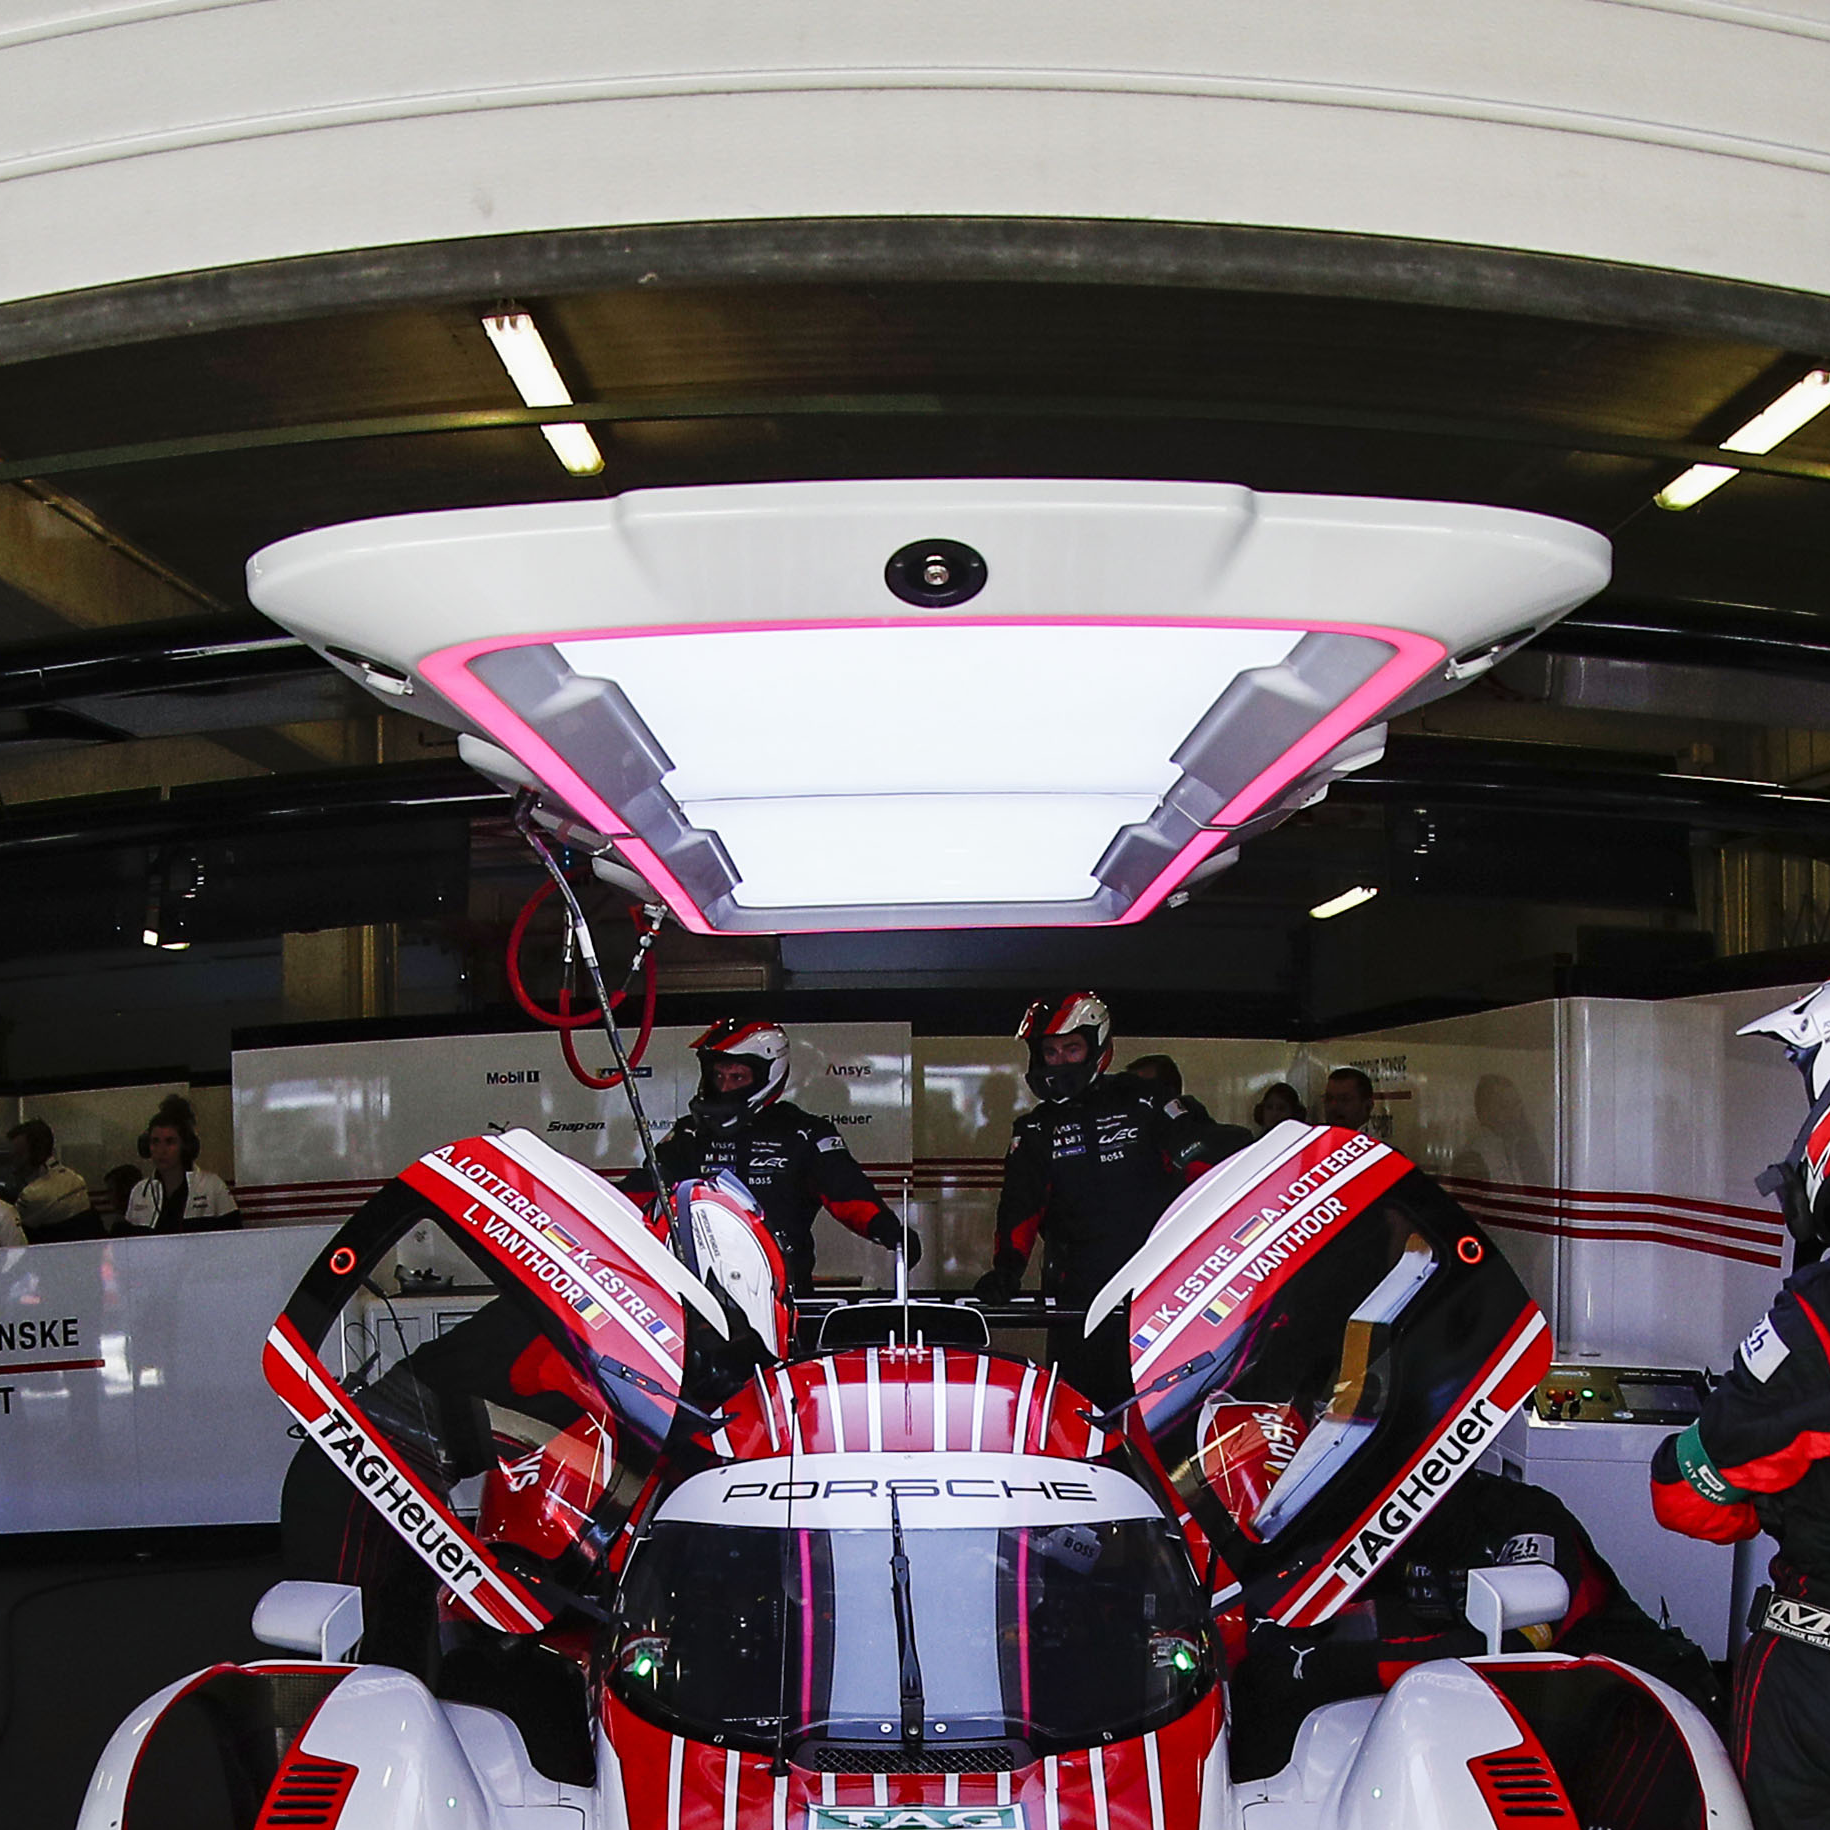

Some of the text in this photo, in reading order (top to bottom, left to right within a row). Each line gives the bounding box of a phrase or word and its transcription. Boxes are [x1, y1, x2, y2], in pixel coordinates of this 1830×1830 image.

[486, 1071, 524, 1085] Mobil
[825, 1064, 871, 1076] Ansys
[547, 1120, 605, 1132] Snap-on
[433, 1145, 657, 1325] A. LOTTERER K. ESTRE
[463, 1203, 585, 1306] L. VANTHOOR
[1155, 1133, 1375, 1323] K. ESTRE A. LOTTERER
[1225, 1197, 1348, 1302] L. VANTHOOR
[319, 1408, 483, 1582] TAGHeuer
[723, 1479, 1098, 1502] PORSCHE
[1334, 1398, 1495, 1578] TAGHeuer
[1064, 1535, 1096, 1559] BOSS
[828, 1810, 1002, 1829] TAG
